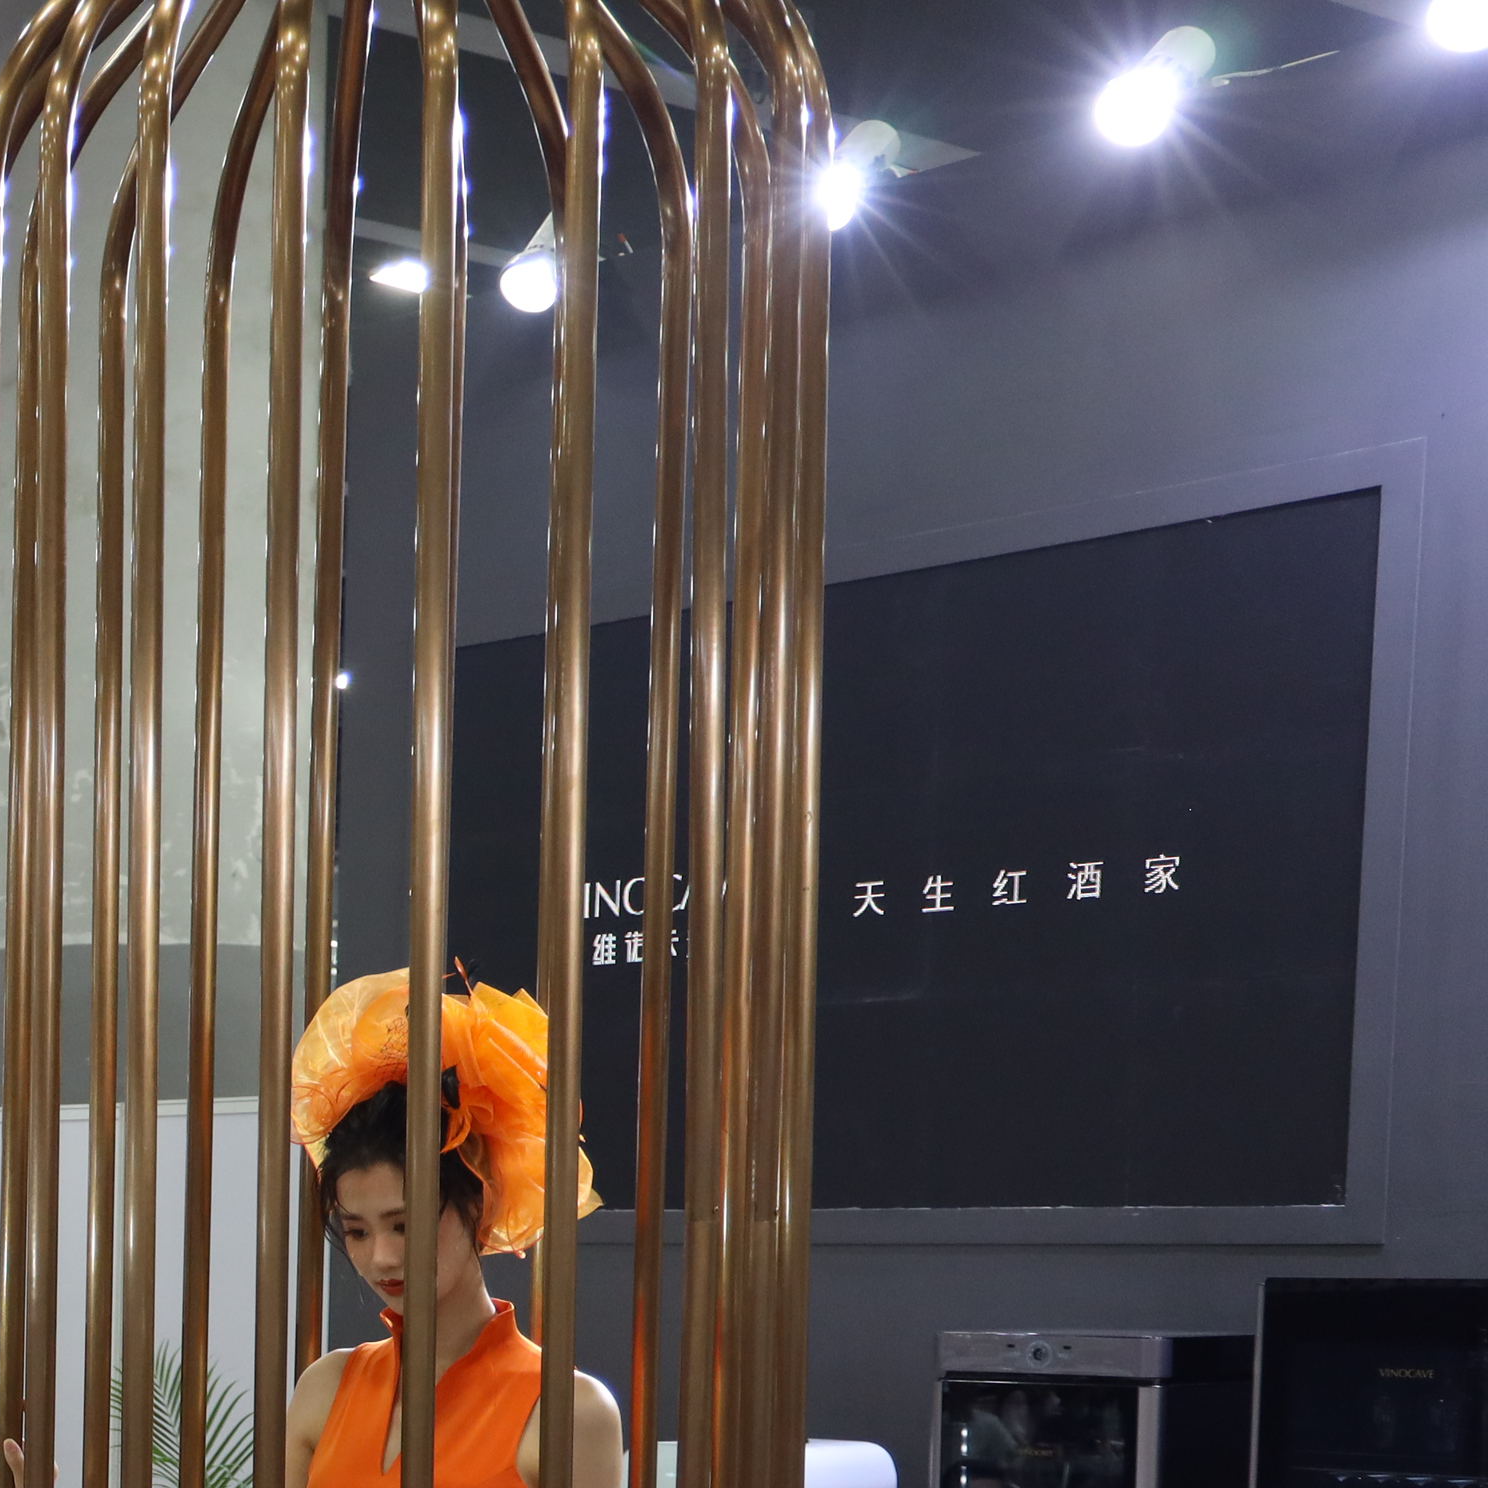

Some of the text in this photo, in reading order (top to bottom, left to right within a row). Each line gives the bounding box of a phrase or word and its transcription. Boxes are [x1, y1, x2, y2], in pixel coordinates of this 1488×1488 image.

[853, 854, 1181, 917] 天生红酒家
[1378, 1368, 1434, 1379] VINOCAVE
